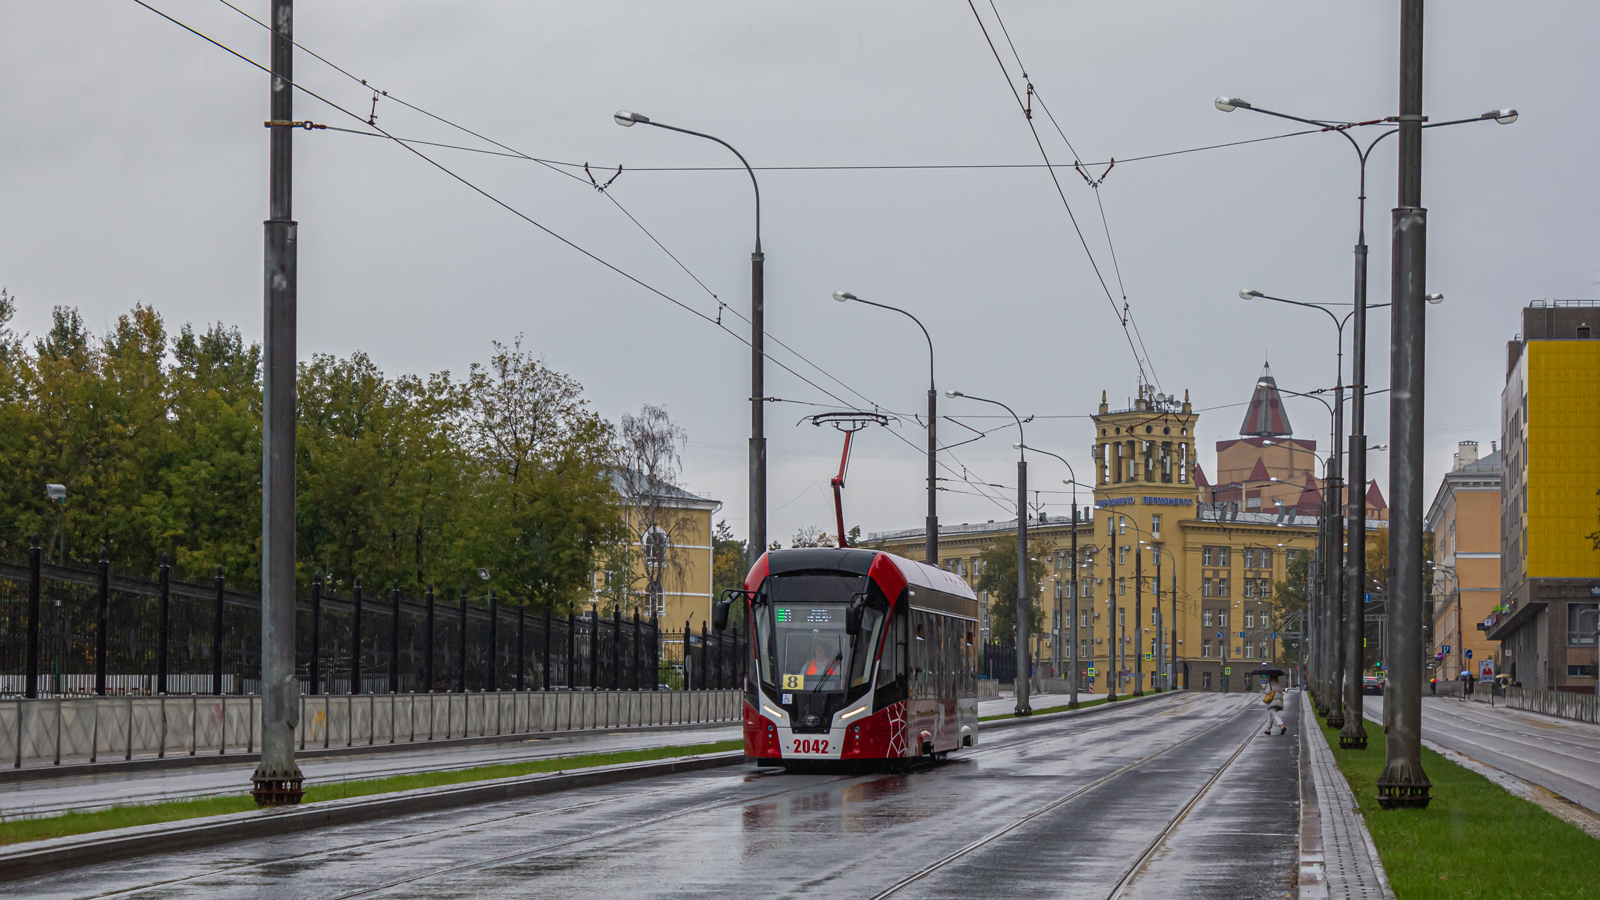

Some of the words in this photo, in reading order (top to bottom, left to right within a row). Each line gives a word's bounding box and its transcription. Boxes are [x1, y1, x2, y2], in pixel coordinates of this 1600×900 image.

[1143, 496, 1193, 506] ПЕРМЭНЕРГО
[787, 676, 798, 688] 8
[793, 739, 829, 754] 2042
